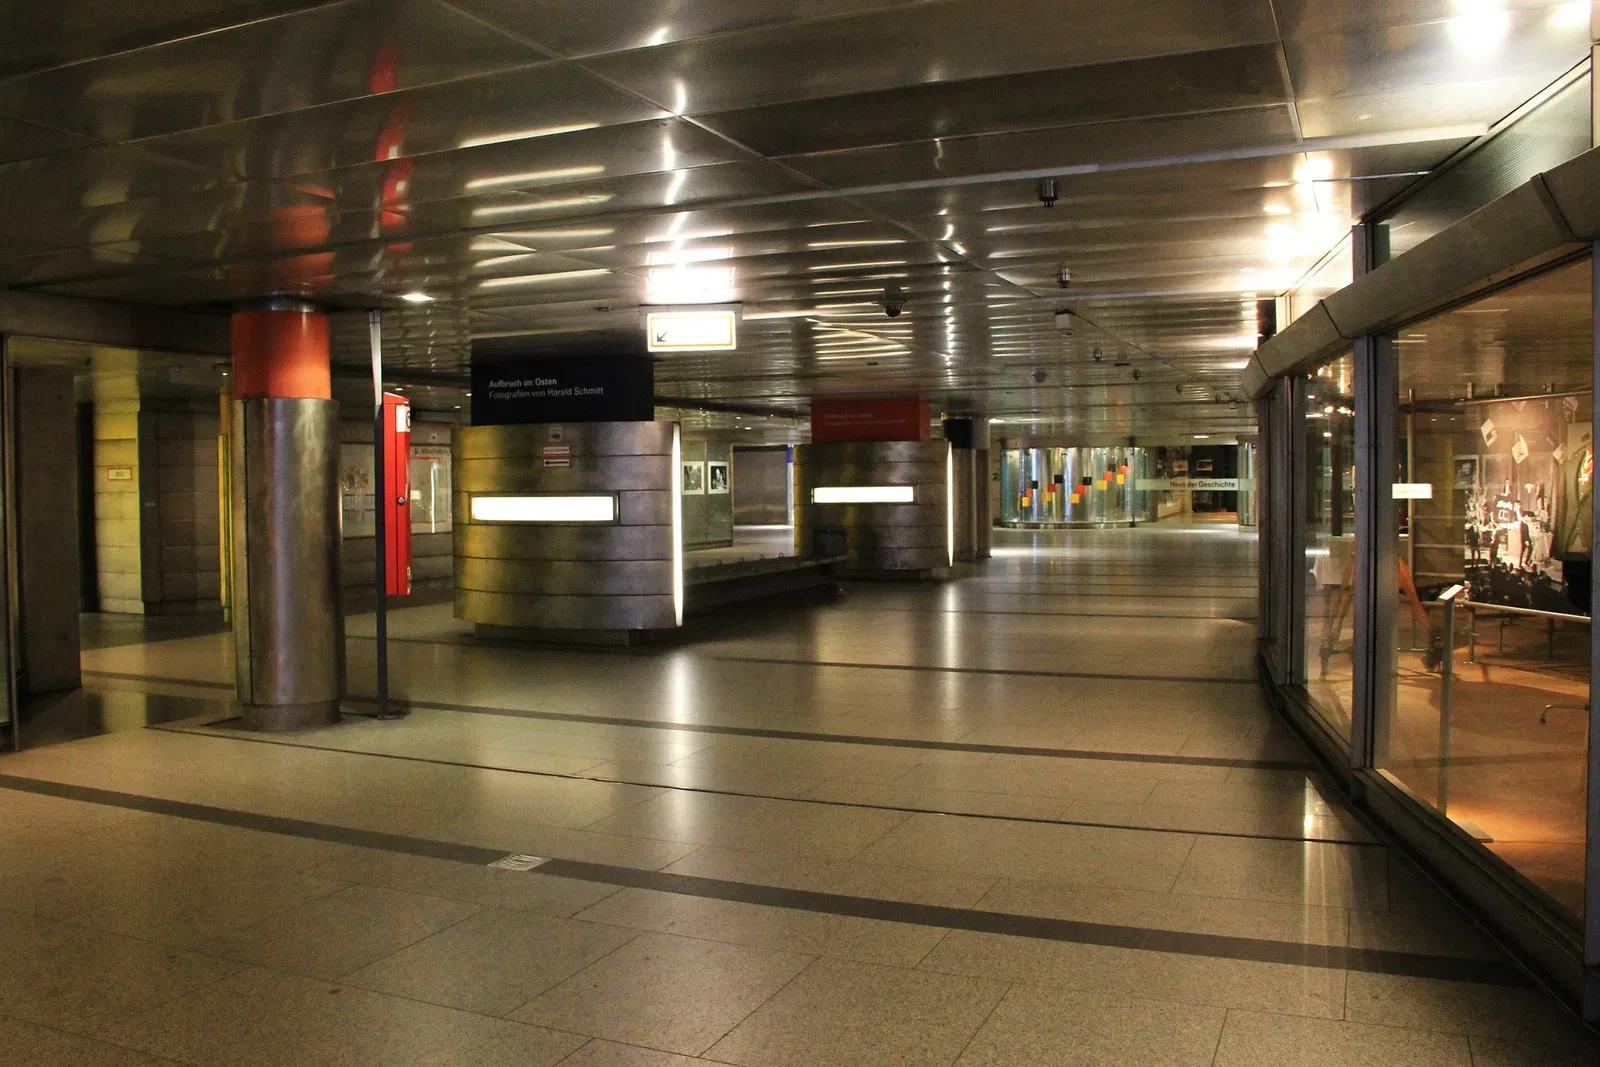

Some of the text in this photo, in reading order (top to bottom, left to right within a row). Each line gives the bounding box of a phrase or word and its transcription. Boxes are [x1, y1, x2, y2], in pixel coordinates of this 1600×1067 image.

[489, 377, 557, 388] Aufbruch im Osten
[488, 390, 530, 400] Fotografien
[547, 388, 572, 397] Harald
[574, 386, 604, 396] Schmitt
